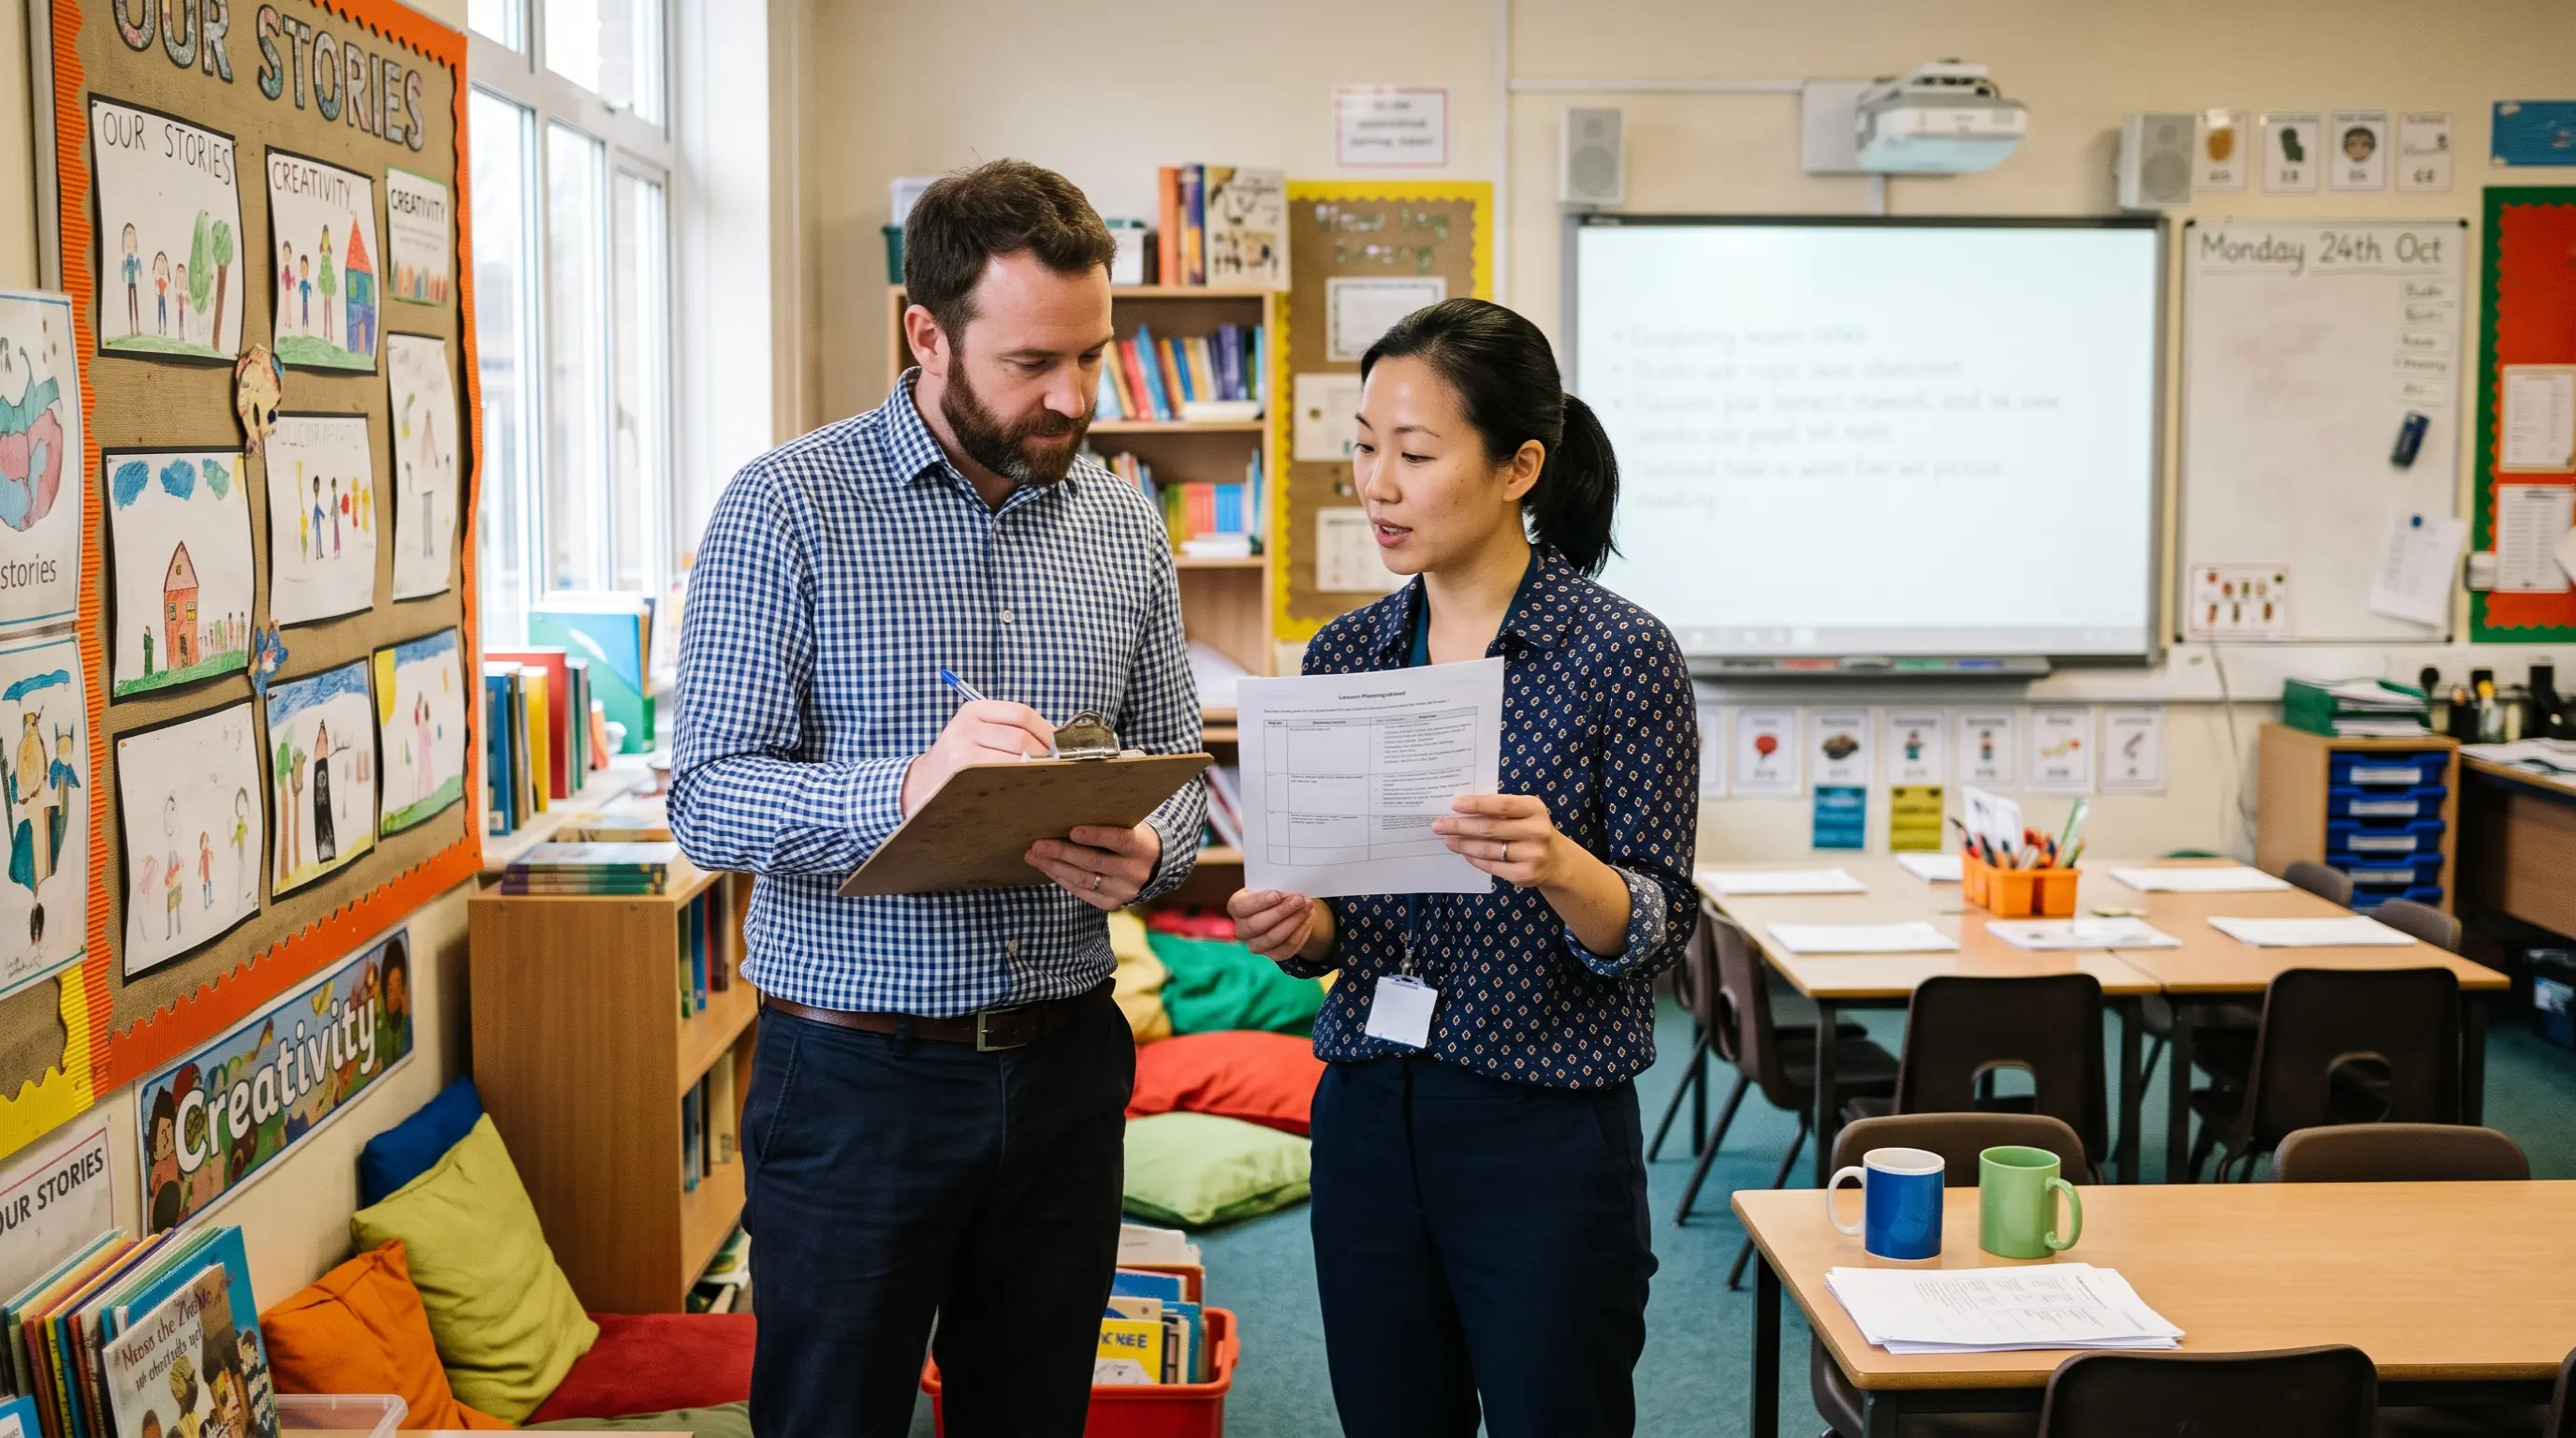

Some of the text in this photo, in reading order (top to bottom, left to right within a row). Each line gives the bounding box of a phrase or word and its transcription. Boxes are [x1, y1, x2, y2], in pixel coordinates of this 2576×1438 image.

[256, 4, 423, 153] STORIES
[103, 111, 231, 185] OUR STORIES
[272, 161, 351, 211] CREATIVITY
[390, 188, 446, 224] CREATIVITY
[2201, 231, 2442, 277] Monday 24th Oct
[0, 553, 57, 590] stories
[175, 997, 375, 1174] Creativity
[37, 1147, 104, 1211] STORIES
